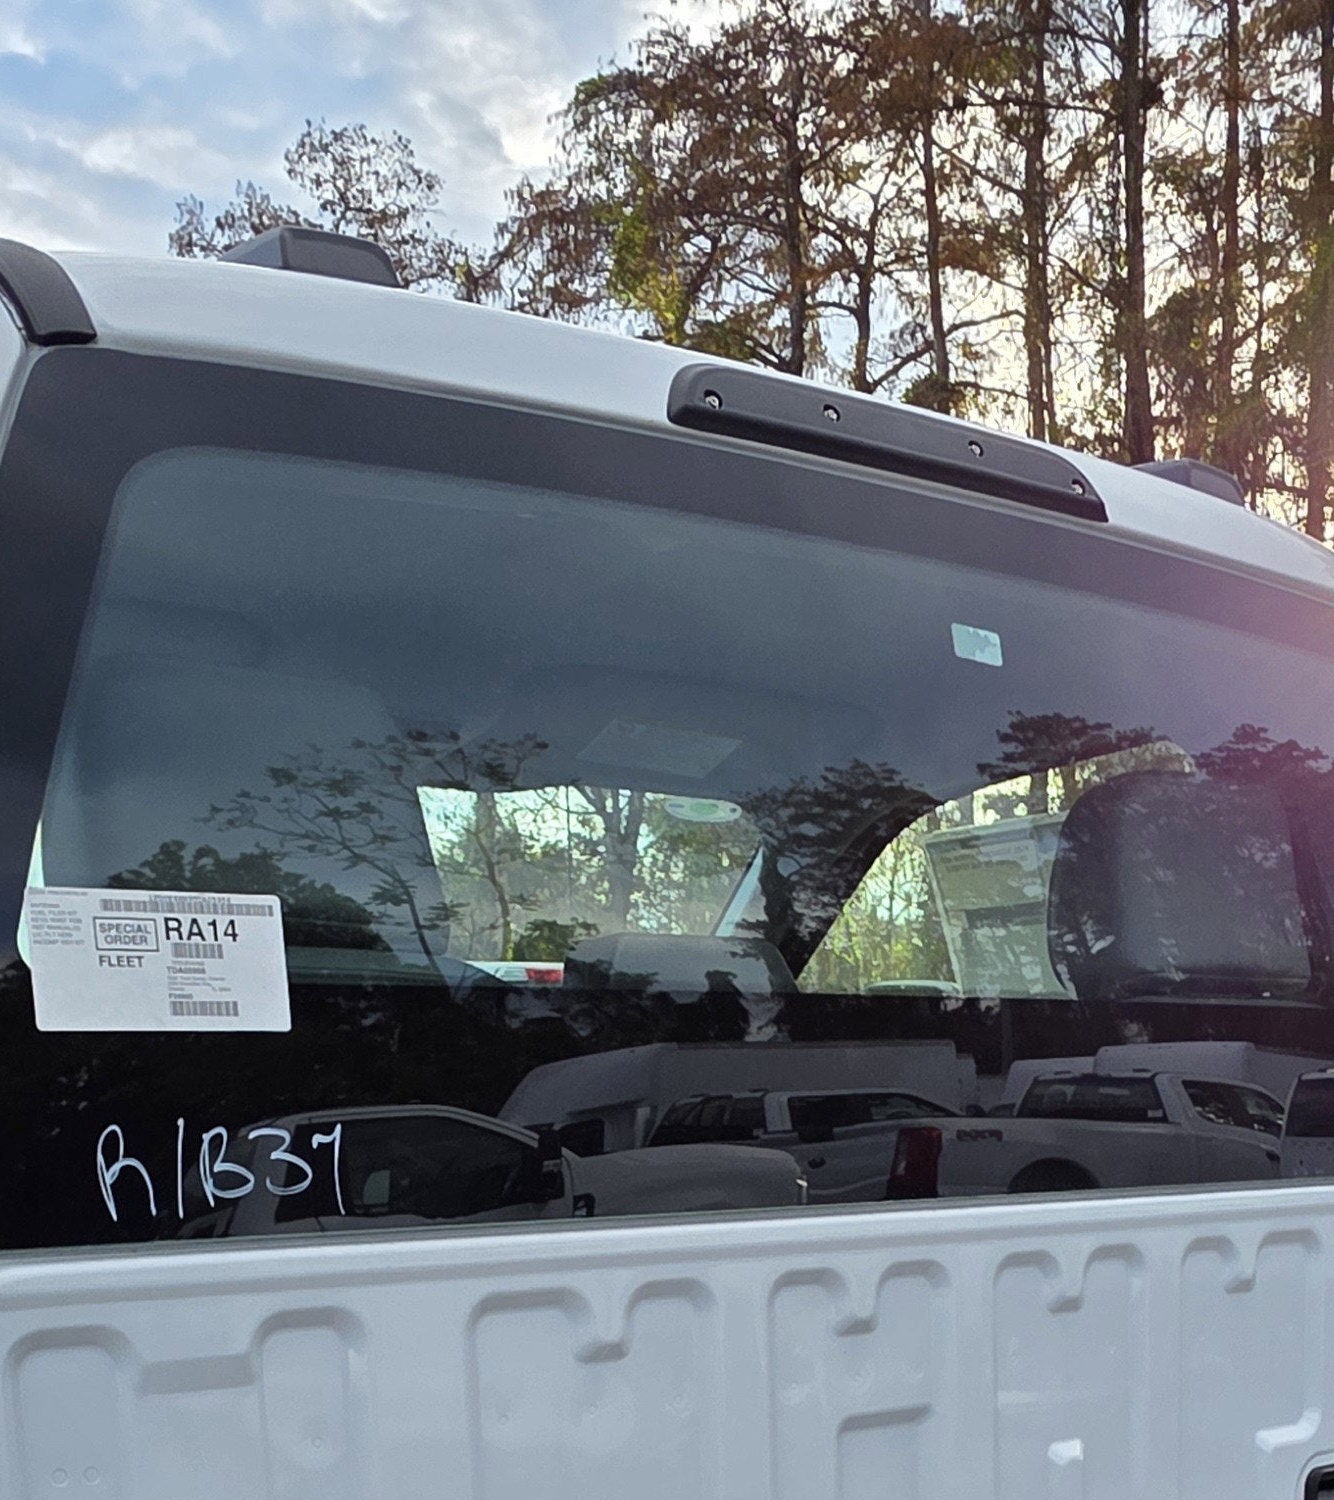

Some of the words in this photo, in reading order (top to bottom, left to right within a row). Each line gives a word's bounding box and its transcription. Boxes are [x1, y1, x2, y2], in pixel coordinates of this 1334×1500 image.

[99, 922, 152, 935] SPECIAL
[164, 917, 239, 942] RA14
[104, 934, 148, 946] ORDER
[98, 954, 145, 968] FLEET
